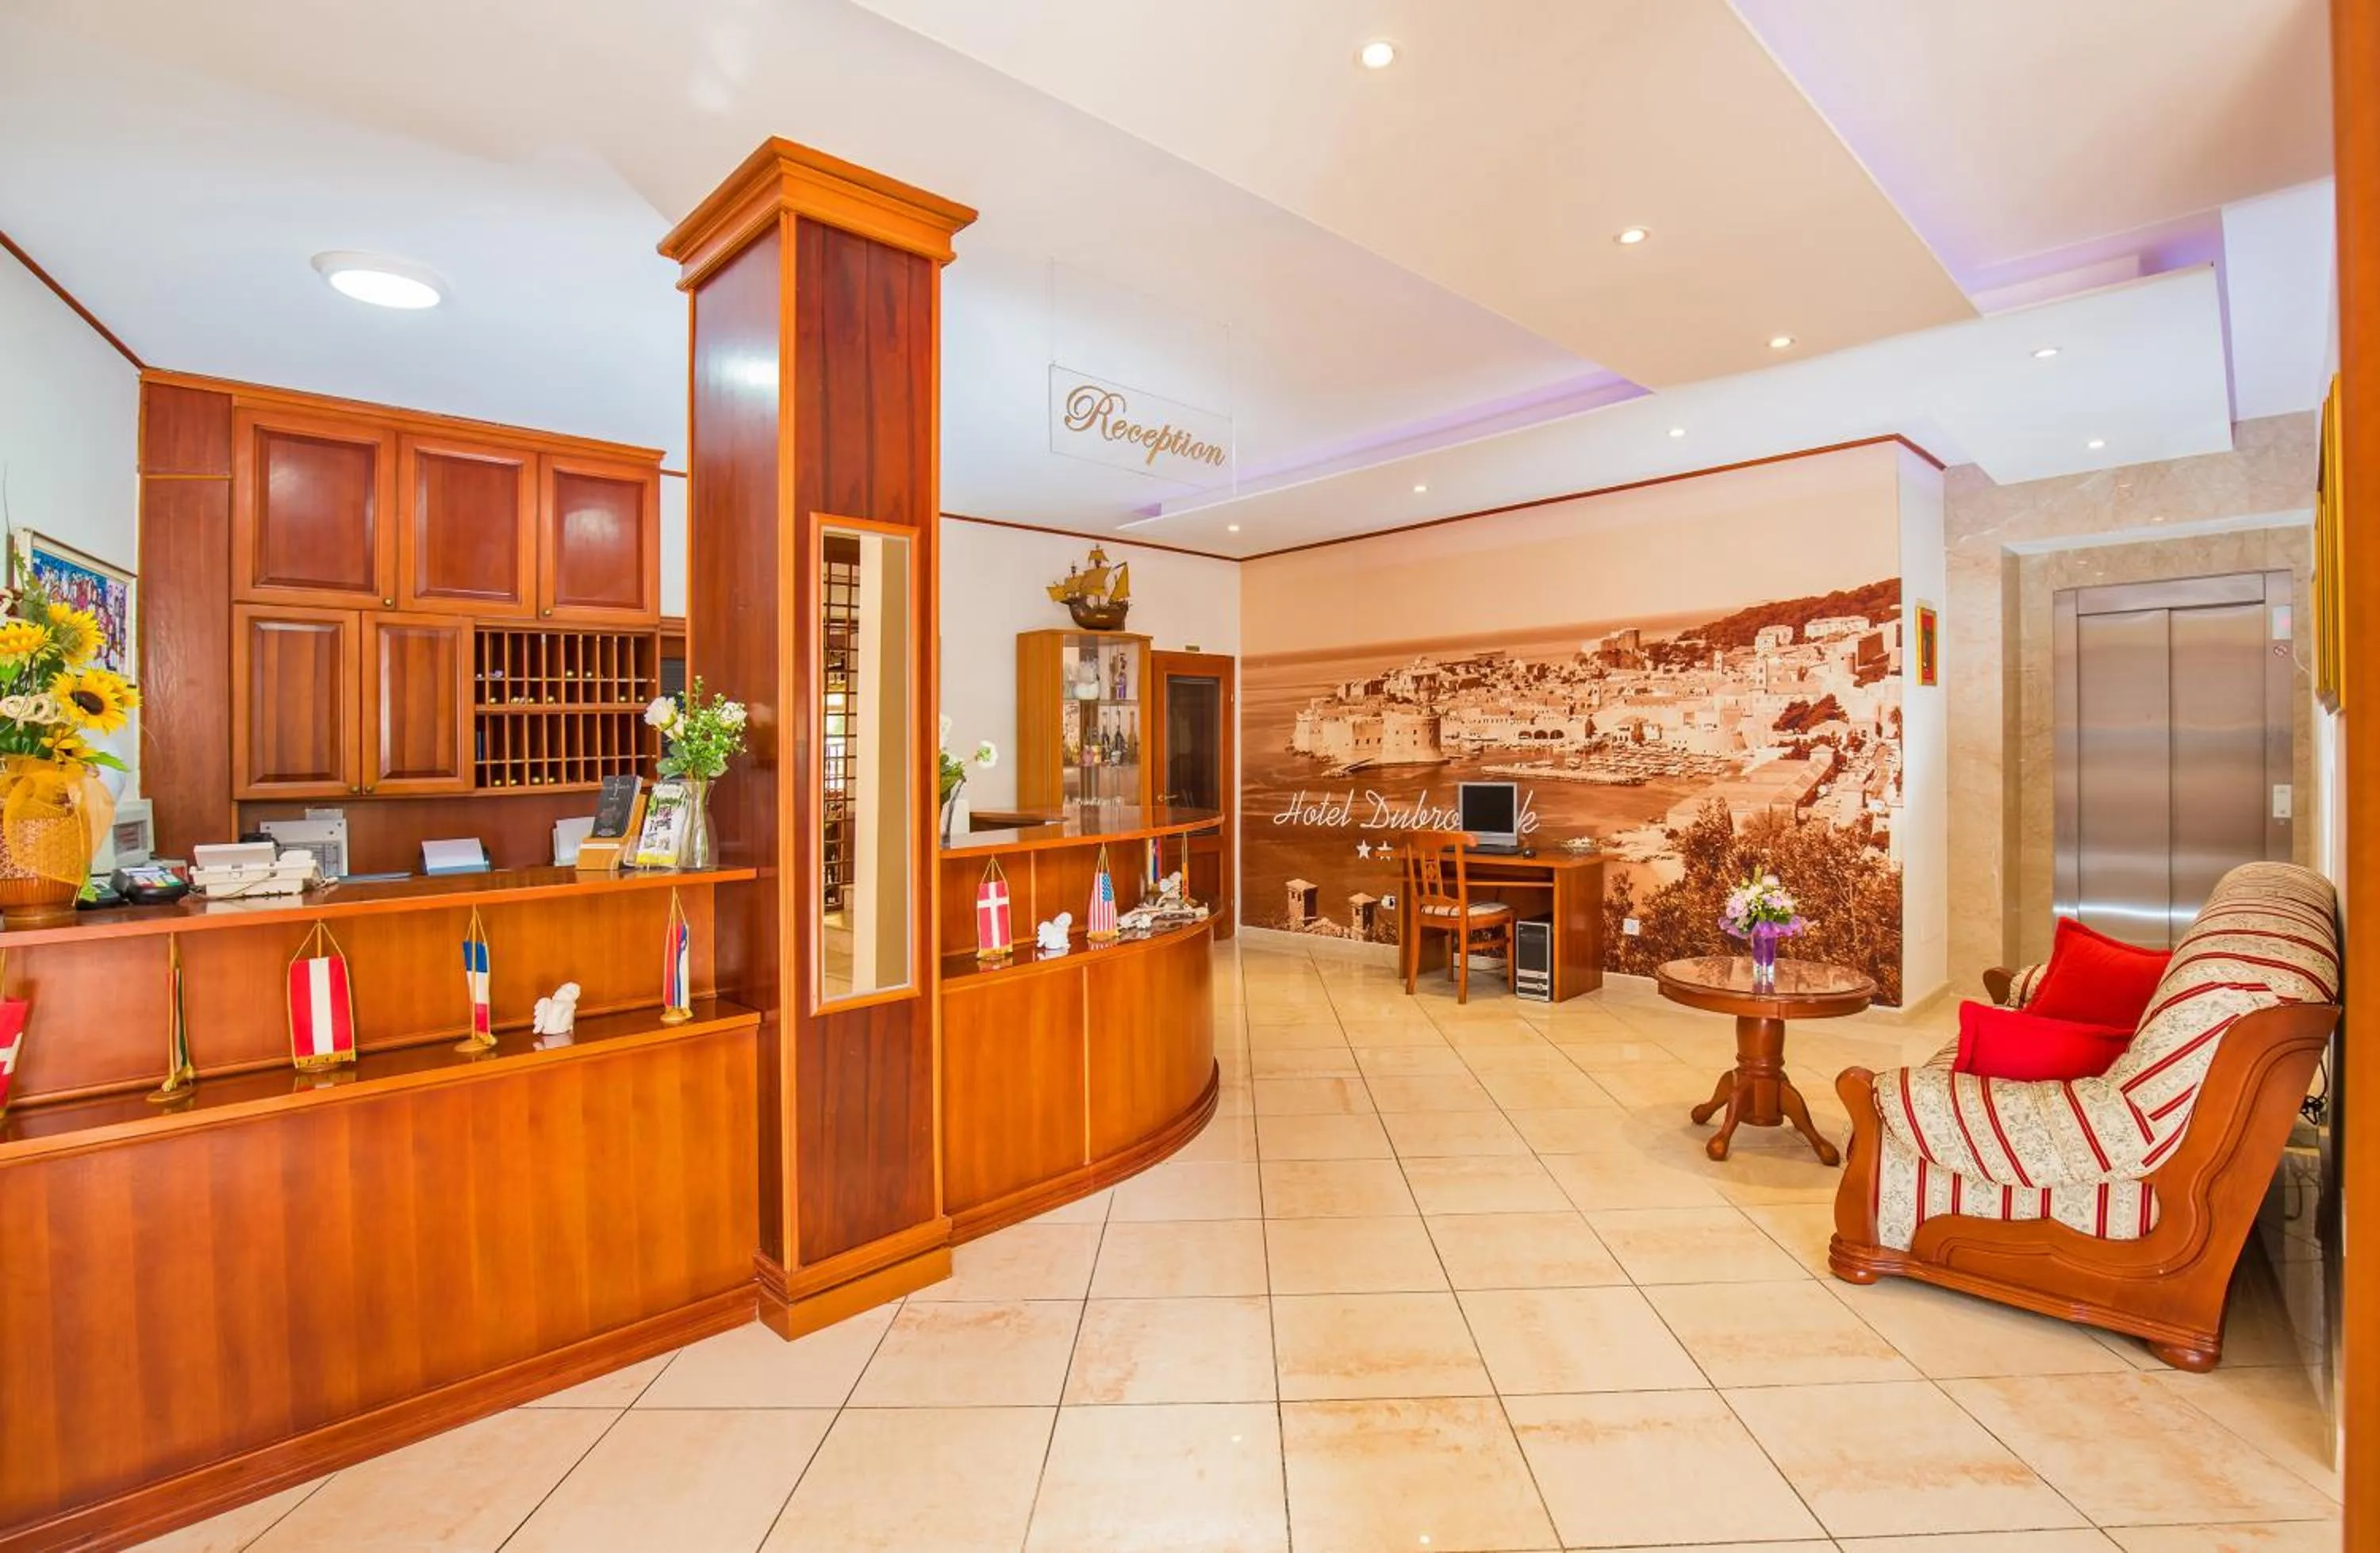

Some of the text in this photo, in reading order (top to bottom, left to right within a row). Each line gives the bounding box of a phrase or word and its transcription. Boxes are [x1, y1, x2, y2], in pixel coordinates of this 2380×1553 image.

[1064, 385, 1226, 467] Reception
[1273, 788, 1541, 834] Hotel Dubrok
